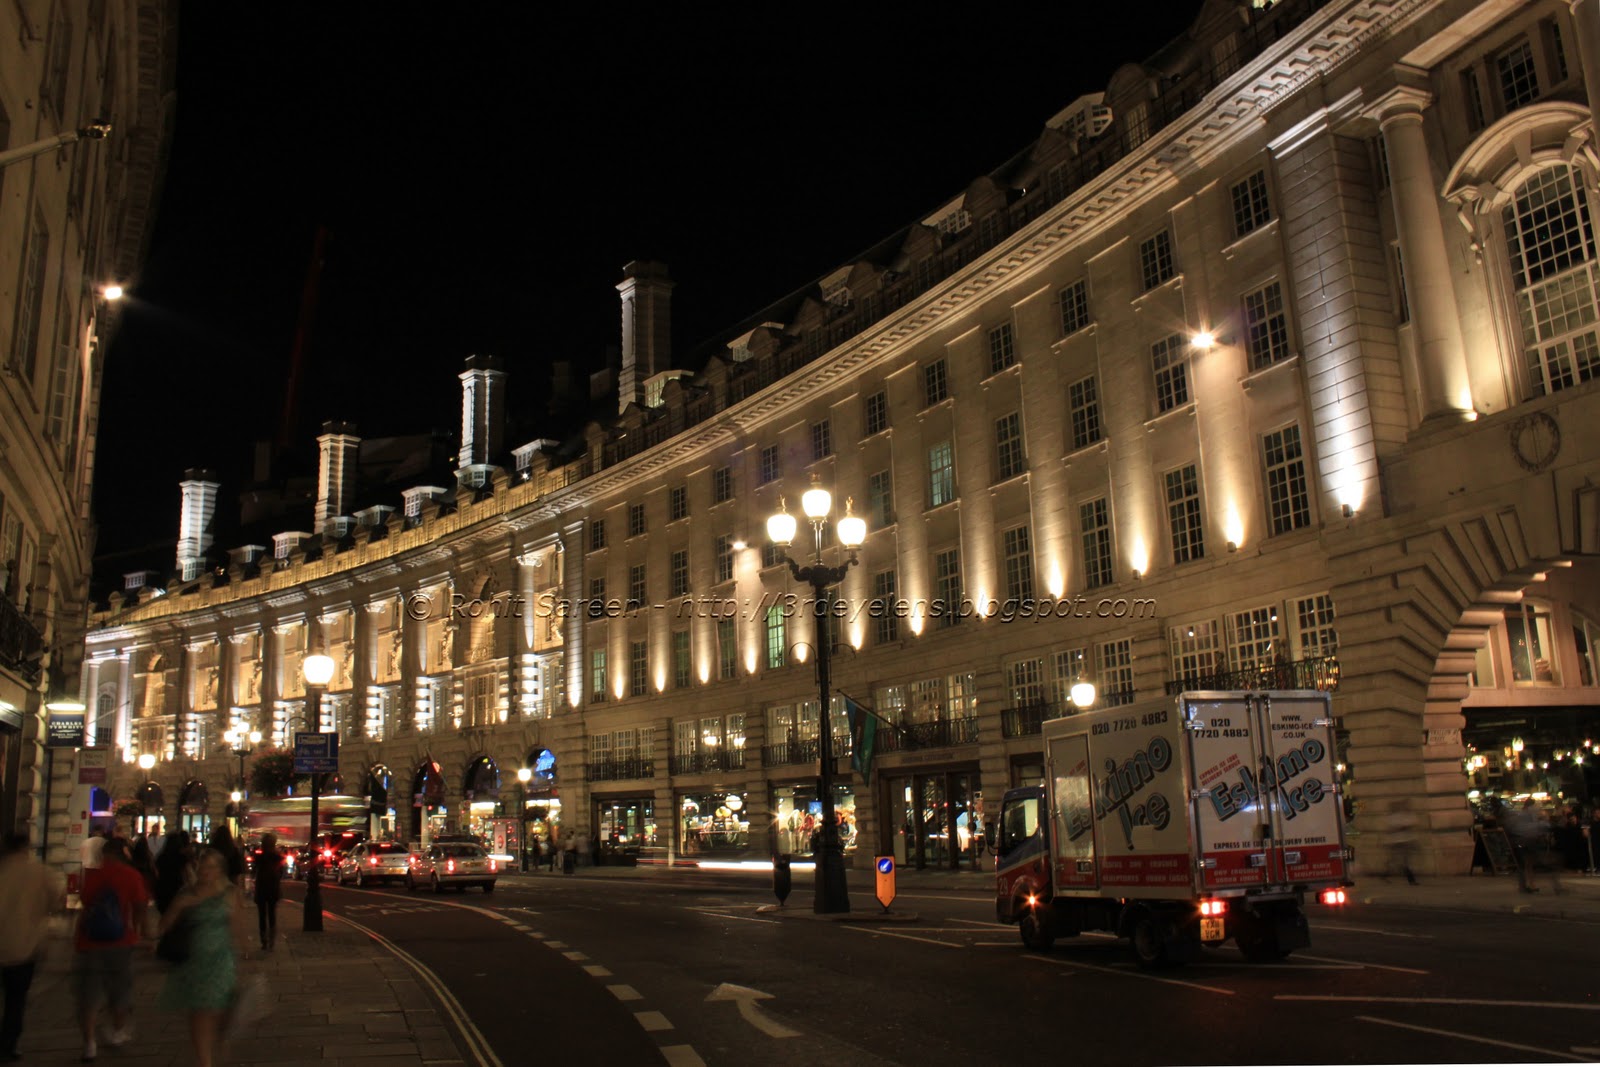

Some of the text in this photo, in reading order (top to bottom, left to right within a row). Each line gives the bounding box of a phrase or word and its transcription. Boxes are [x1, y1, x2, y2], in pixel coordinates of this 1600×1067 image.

[1092, 711, 1168, 735] 020 7720 4883
[1211, 718, 1230, 727] 020
[1194, 728, 1249, 738] 7720 4883
[1277, 777, 1325, 821] Ice
[1118, 793, 1171, 851] Ice
[1214, 842, 1240, 850] EXPRESS
[1304, 836, 1326, 844] SERVICE
